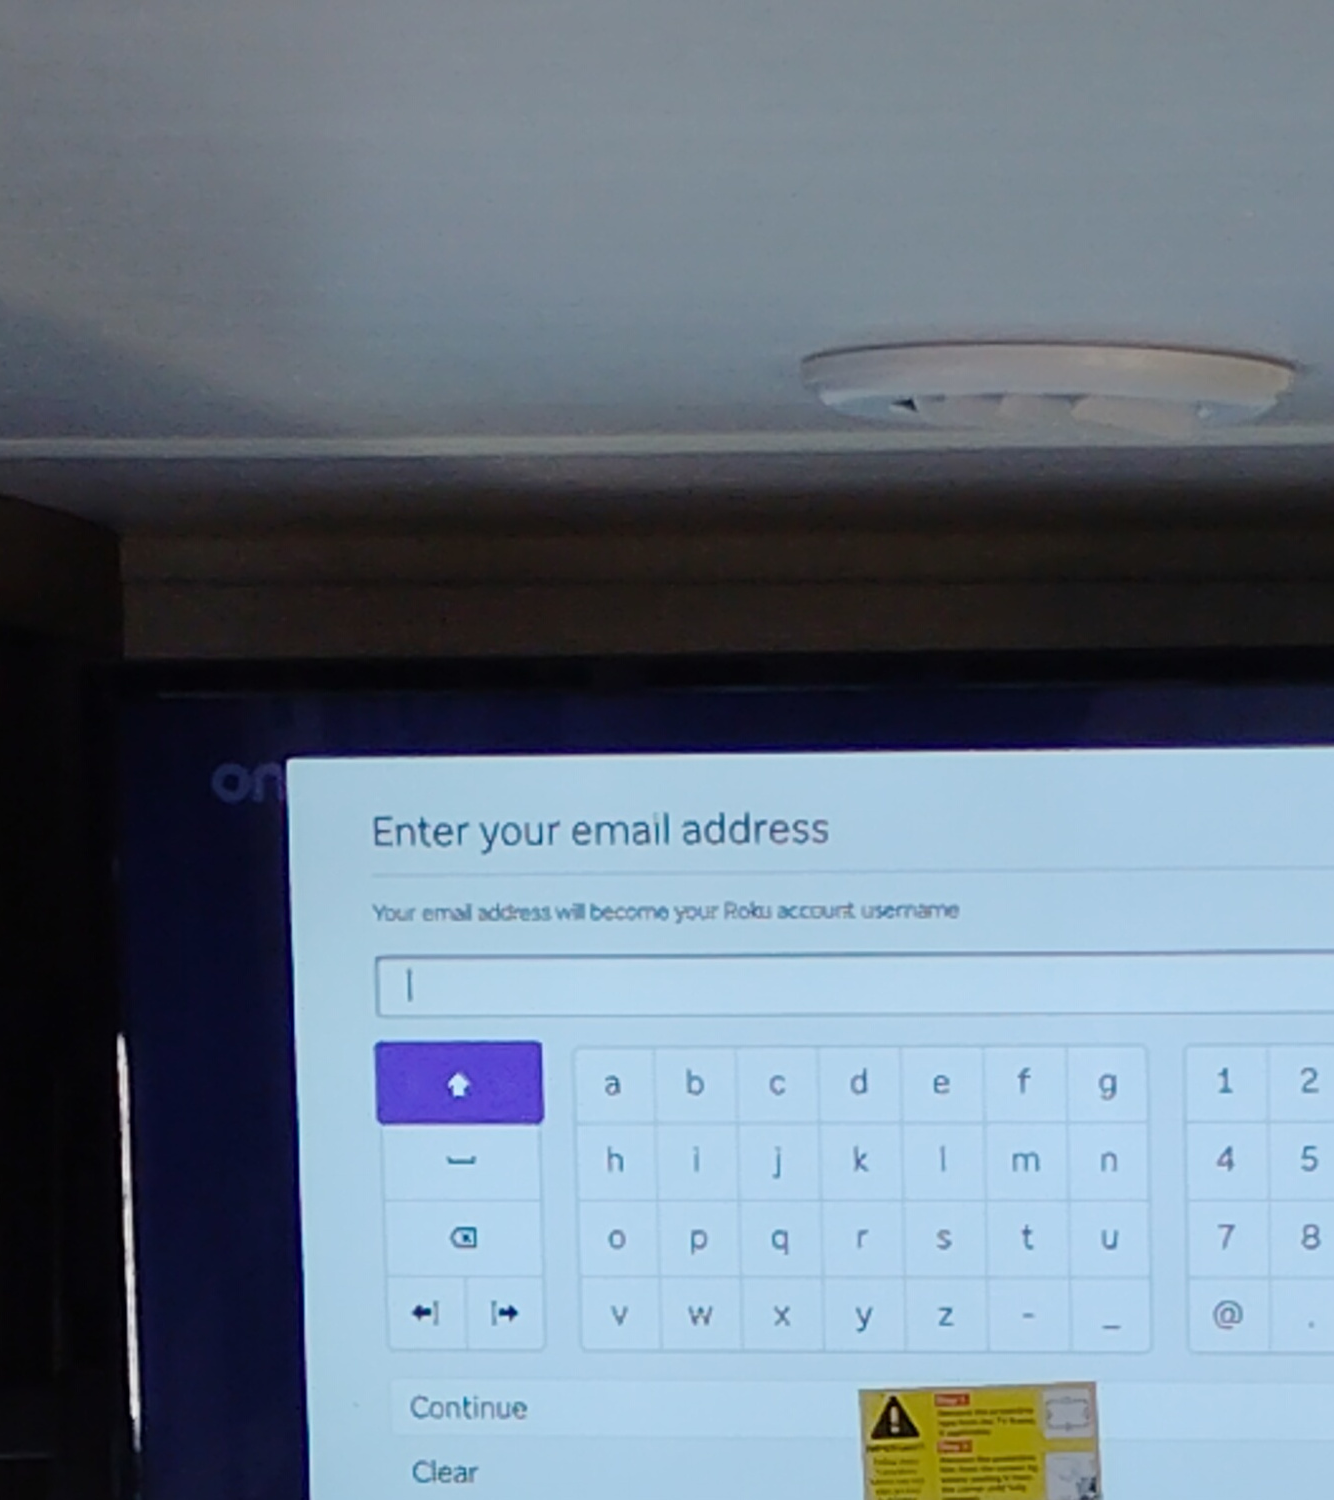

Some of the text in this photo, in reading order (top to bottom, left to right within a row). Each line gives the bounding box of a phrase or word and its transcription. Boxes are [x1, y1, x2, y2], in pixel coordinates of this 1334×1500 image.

[372, 810, 830, 856] Enter your email address
[370, 900, 961, 926] Your email address will become your Roku account username
[604, 1066, 1119, 1102] a b c d e f g
[1217, 1066, 1234, 1095] 1
[1299, 1065, 1320, 1095] 2
[606, 1145, 625, 1174] h
[771, 1145, 782, 1181] j
[852, 1145, 870, 1173] k
[1011, 1150, 1042, 1173] m
[1099, 1150, 1119, 1173] n
[1215, 1144, 1236, 1173] 4
[1300, 1144, 1320, 1174] 5
[606, 1223, 1120, 1257] o p q r s t u
[1216, 1222, 1237, 1251] 7
[1299, 1222, 1323, 1252] 8
[609, 1304, 630, 1328] v
[687, 1304, 714, 1327] w
[772, 1304, 792, 1328] x
[854, 1306, 874, 1334] y
[937, 1305, 955, 1328] z
[409, 1394, 529, 1421] Continue
[411, 1459, 480, 1485] Clear
